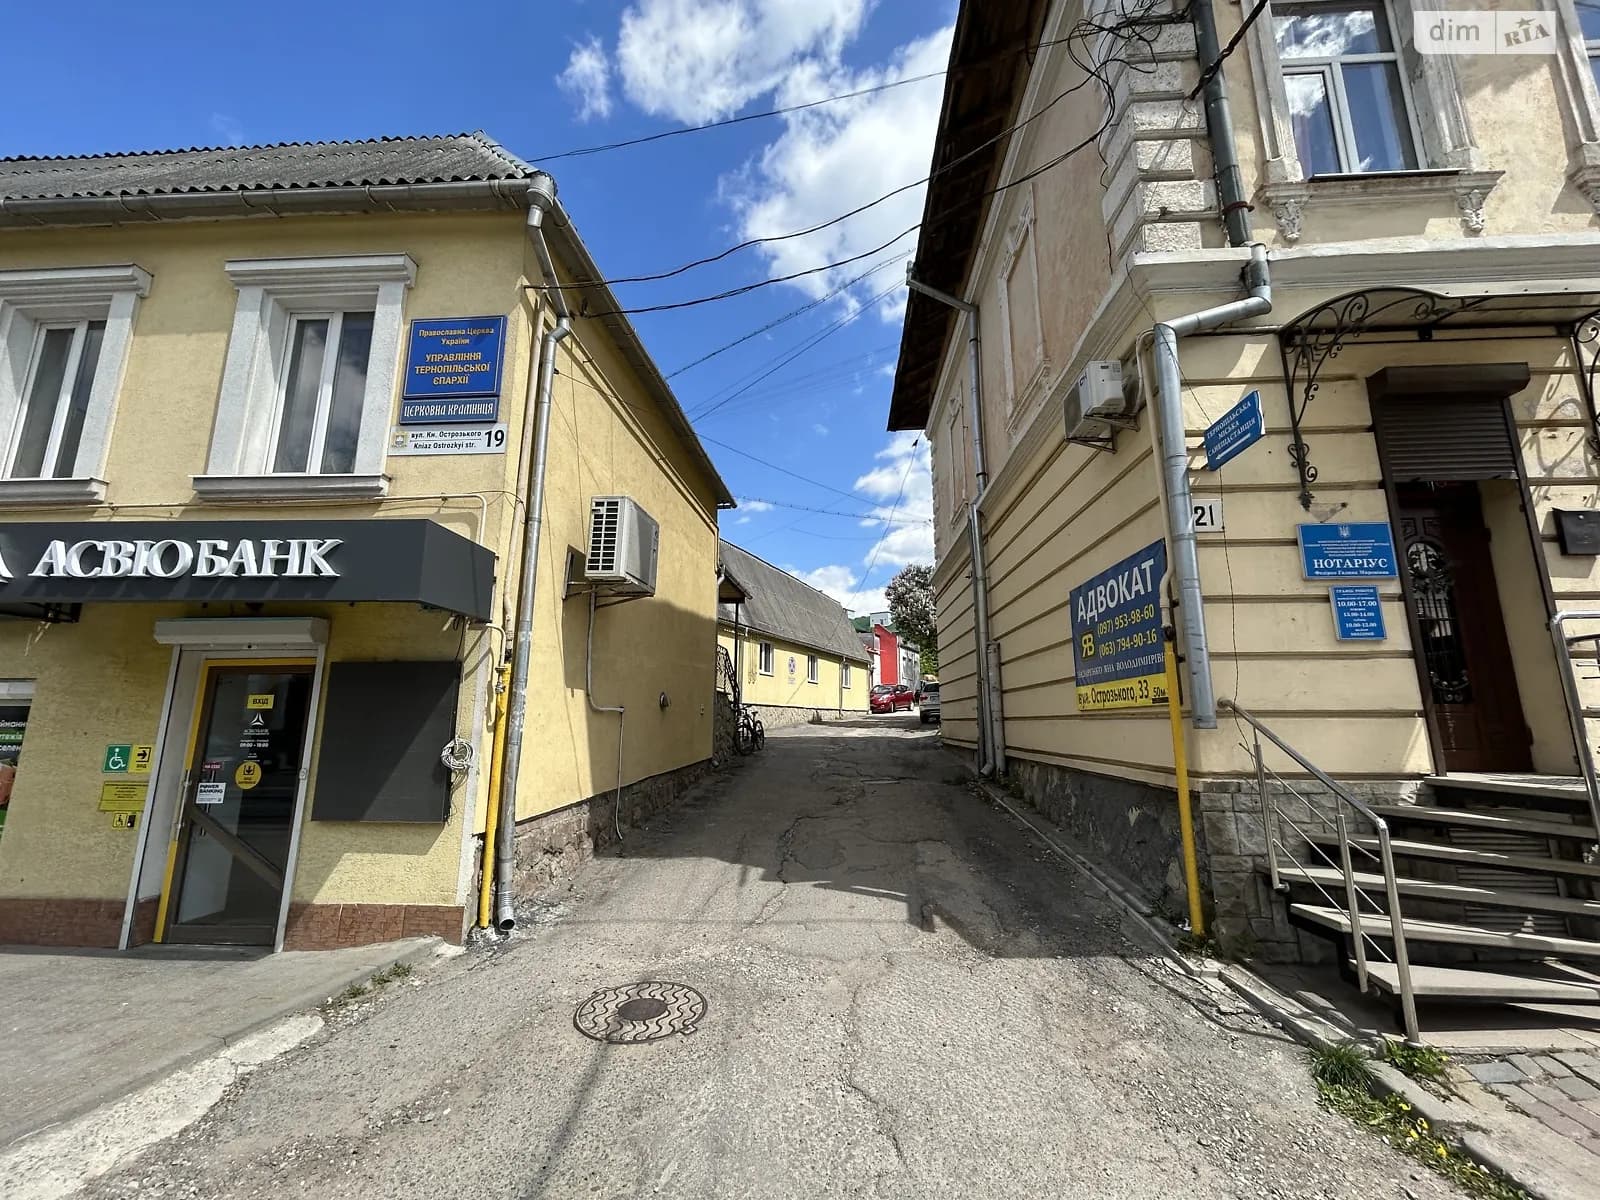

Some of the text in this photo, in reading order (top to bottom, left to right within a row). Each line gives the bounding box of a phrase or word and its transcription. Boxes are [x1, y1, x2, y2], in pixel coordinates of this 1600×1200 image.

[467, 327, 495, 336] Церква
[441, 337, 470, 346] України
[425, 352, 482, 362] УПРАВЛІННЯ
[415, 361, 491, 374] ТЕРНОПІЛЬСЬКОЇ
[433, 373, 469, 385] ЄПАРХІЇ
[439, 431, 482, 439] Острозького
[484, 429, 505, 447] 19
[433, 441, 464, 450] Ostrozkyi
[1194, 504, 1214, 526] 21
[1313, 558, 1388, 569] НОТАРІУС
[1077, 558, 1154, 625] АДВОКАТ
[1098, 603, 1155, 638] (097) 953-98-60
[1099, 628, 1157, 658] (063) 794-90-16
[1138, 679, 1149, 699] 33
